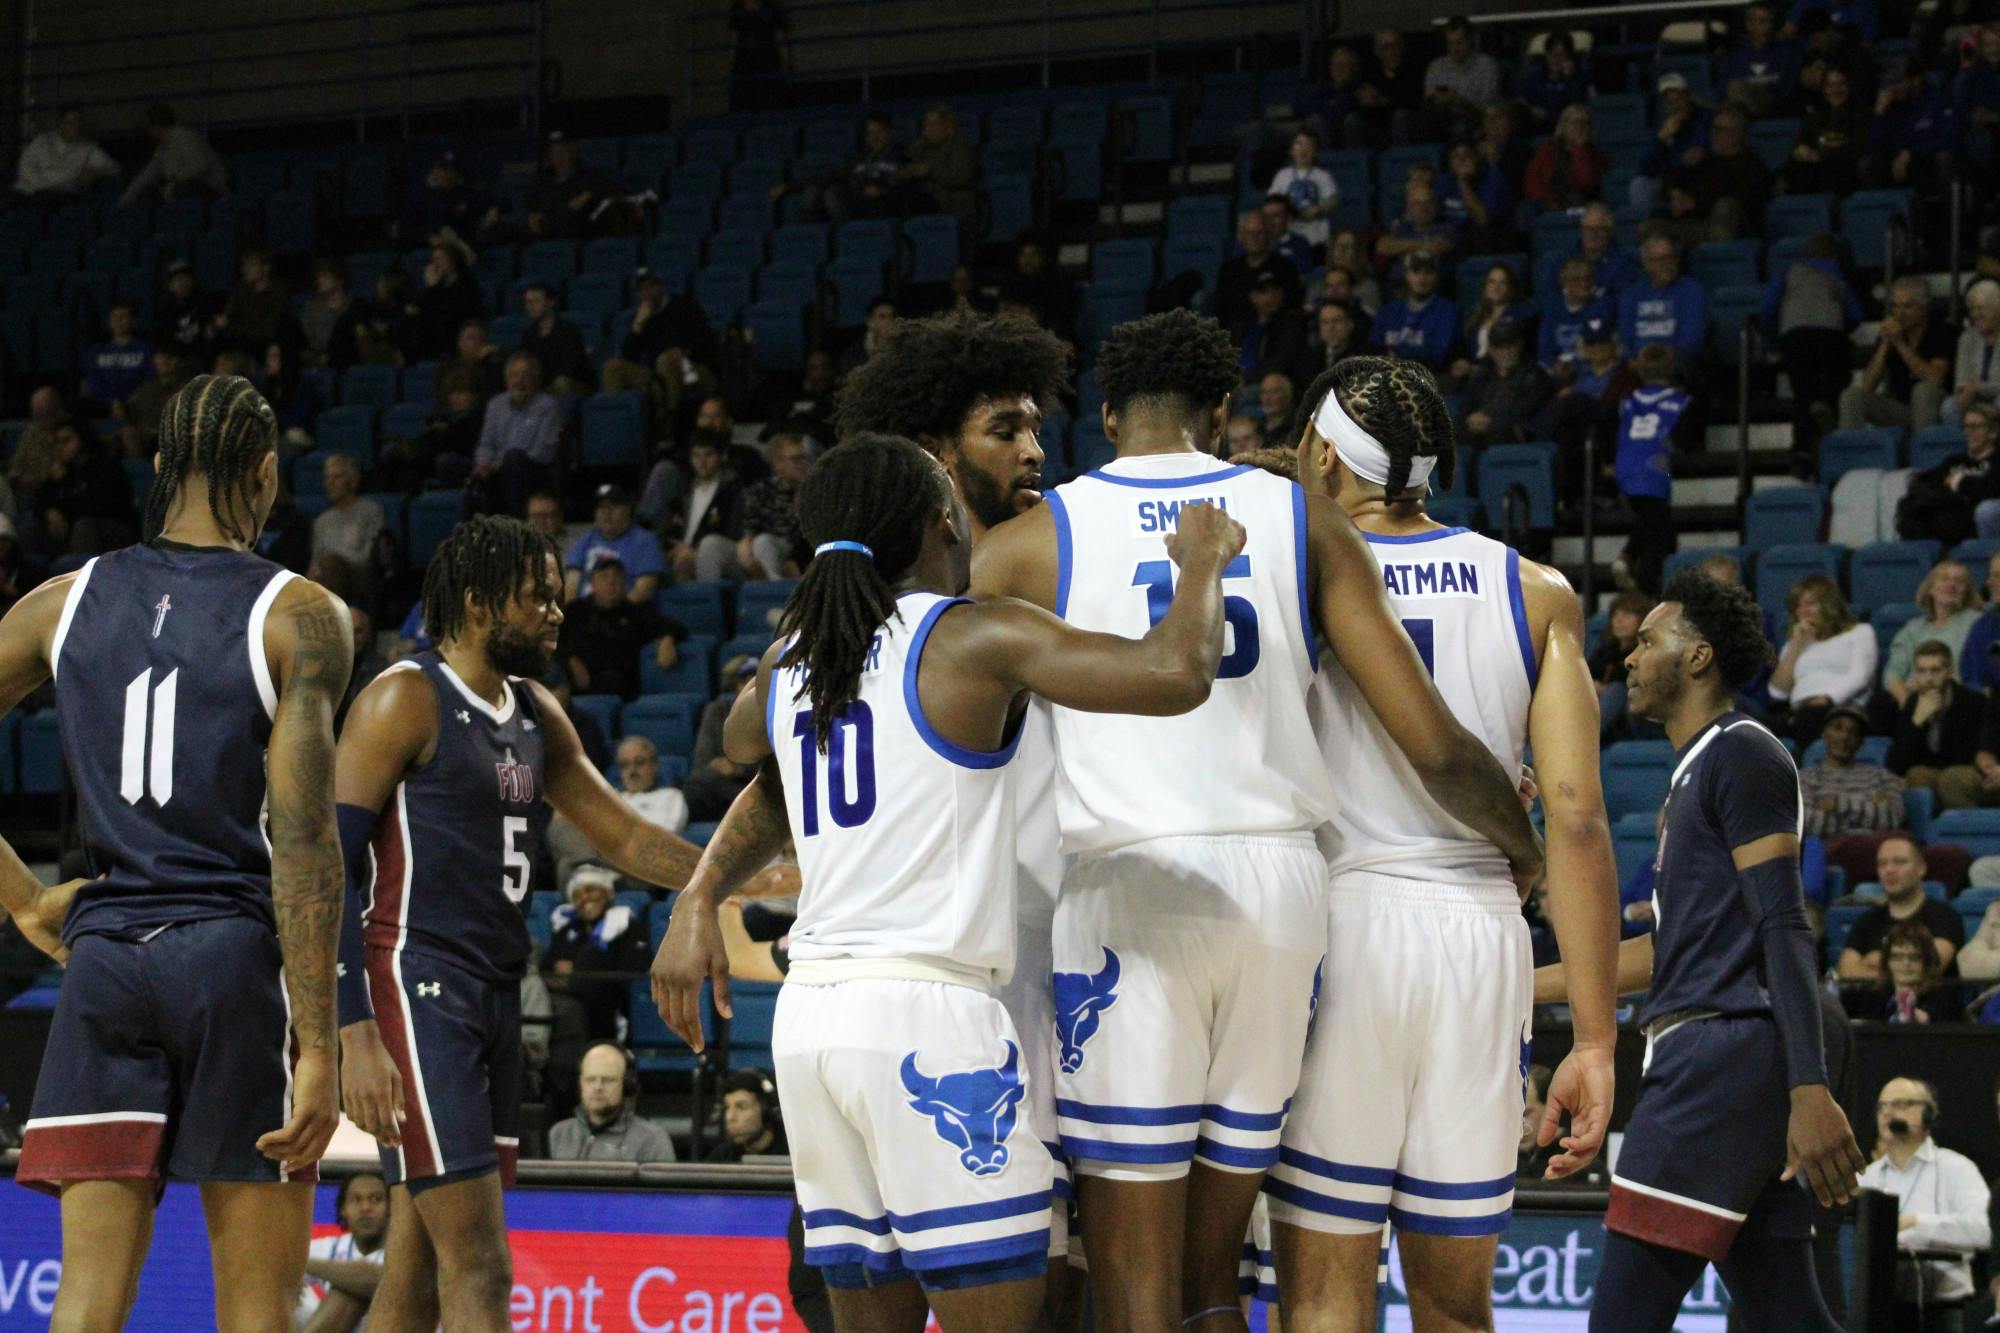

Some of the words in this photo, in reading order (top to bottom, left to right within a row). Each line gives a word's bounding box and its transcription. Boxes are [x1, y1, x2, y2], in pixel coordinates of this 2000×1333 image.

[1384, 562, 1478, 595] ATMAN
[120, 666, 179, 808] 11
[793, 699, 876, 837] 10
[496, 762, 534, 804] FDU
[503, 816, 530, 904] 5
[510, 1275, 604, 1333] ent
[628, 1265, 783, 1333] Care
